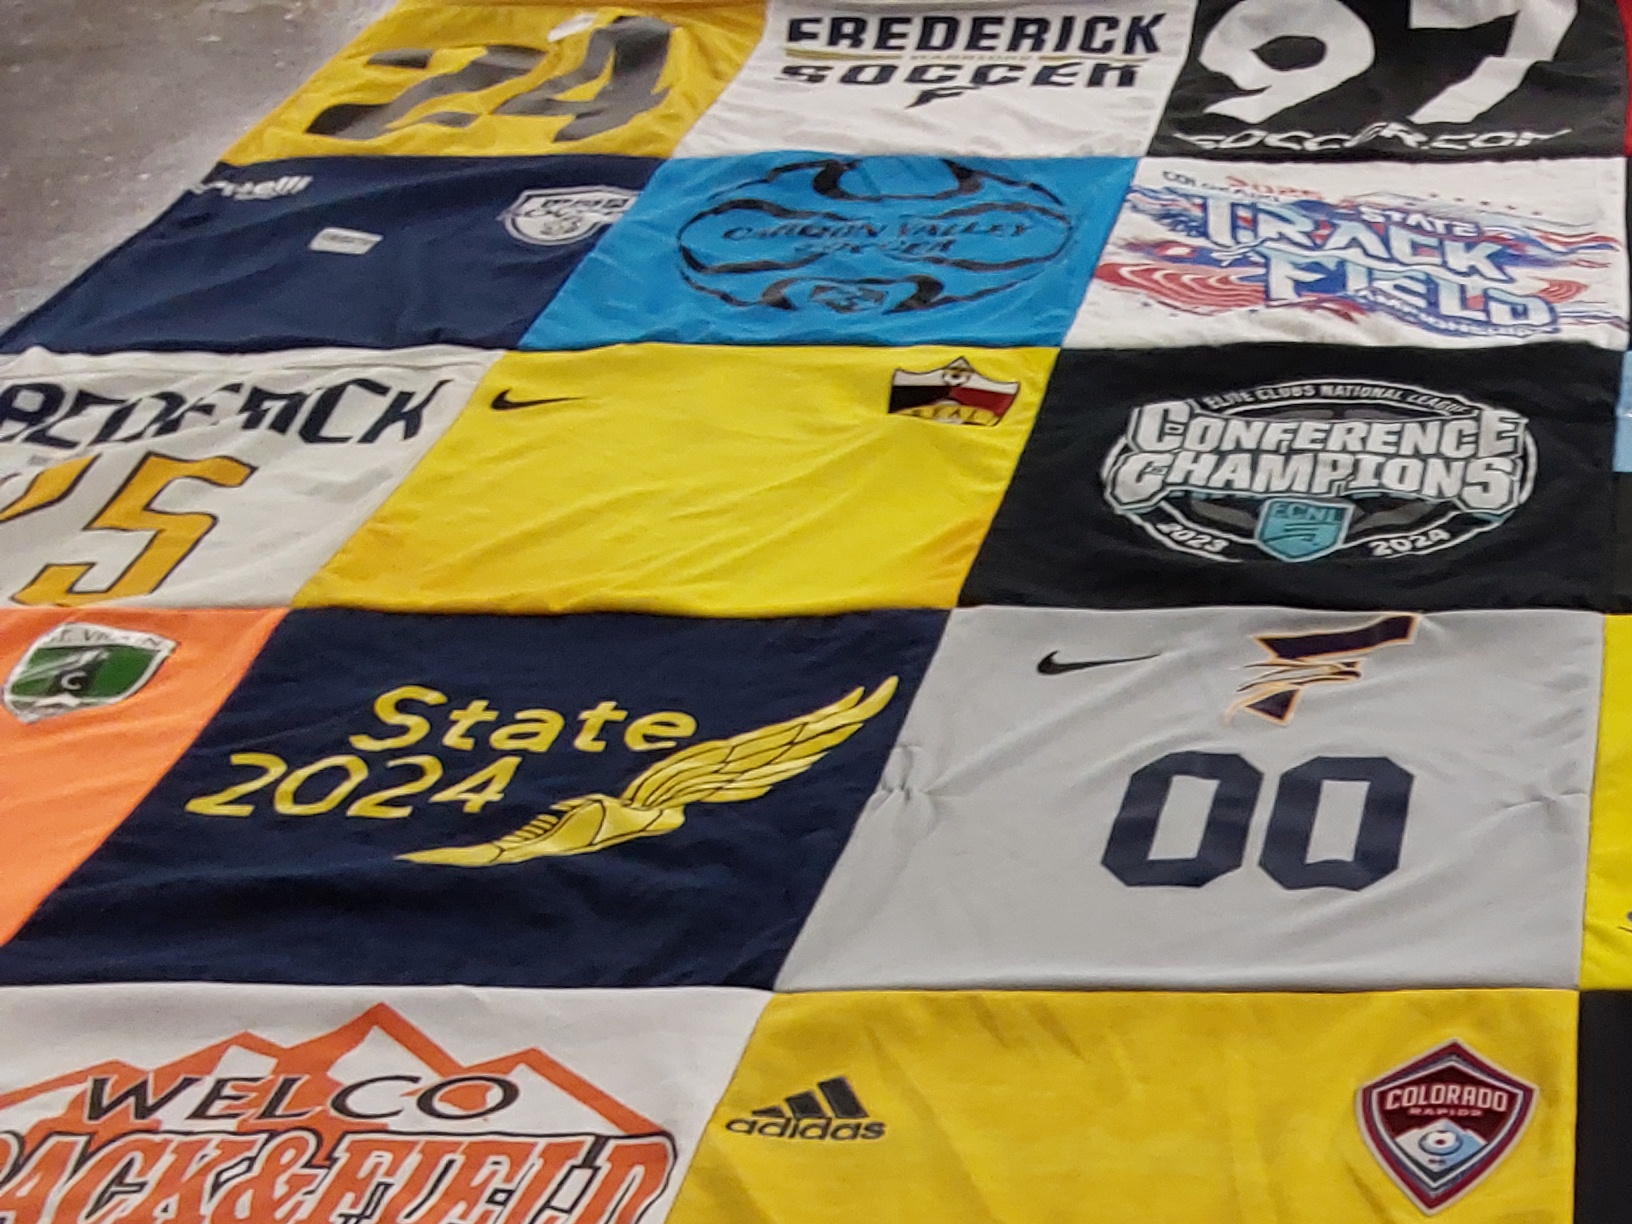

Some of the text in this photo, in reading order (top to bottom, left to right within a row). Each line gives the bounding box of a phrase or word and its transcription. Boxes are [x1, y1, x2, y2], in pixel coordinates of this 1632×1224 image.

[786, 13, 1166, 54] FREDERICK
[306, 15, 676, 142] 24
[775, 61, 1143, 88] SOCCER
[1199, 0, 1577, 124] 97
[1204, 199, 1516, 284] TRACK
[1357, 205, 1479, 238] STATE
[1265, 246, 1557, 326] FIELD
[1318, 384, 1403, 401] NATIONAL
[1135, 400, 1524, 459] CONFERENCE
[1111, 452, 1519, 510] CHAMPIONS
[1269, 503, 1343, 522] ECNL
[1368, 529, 1452, 557] 2024
[348, 684, 697, 754] State
[185, 752, 521, 819] 2024
[1101, 750, 1415, 892] 00
[82, 1074, 520, 1123] WELCO
[1384, 1083, 1509, 1113] COLORADO
[1408, 1108, 1484, 1118] RAPIDS
[725, 1117, 887, 1141] adidas
